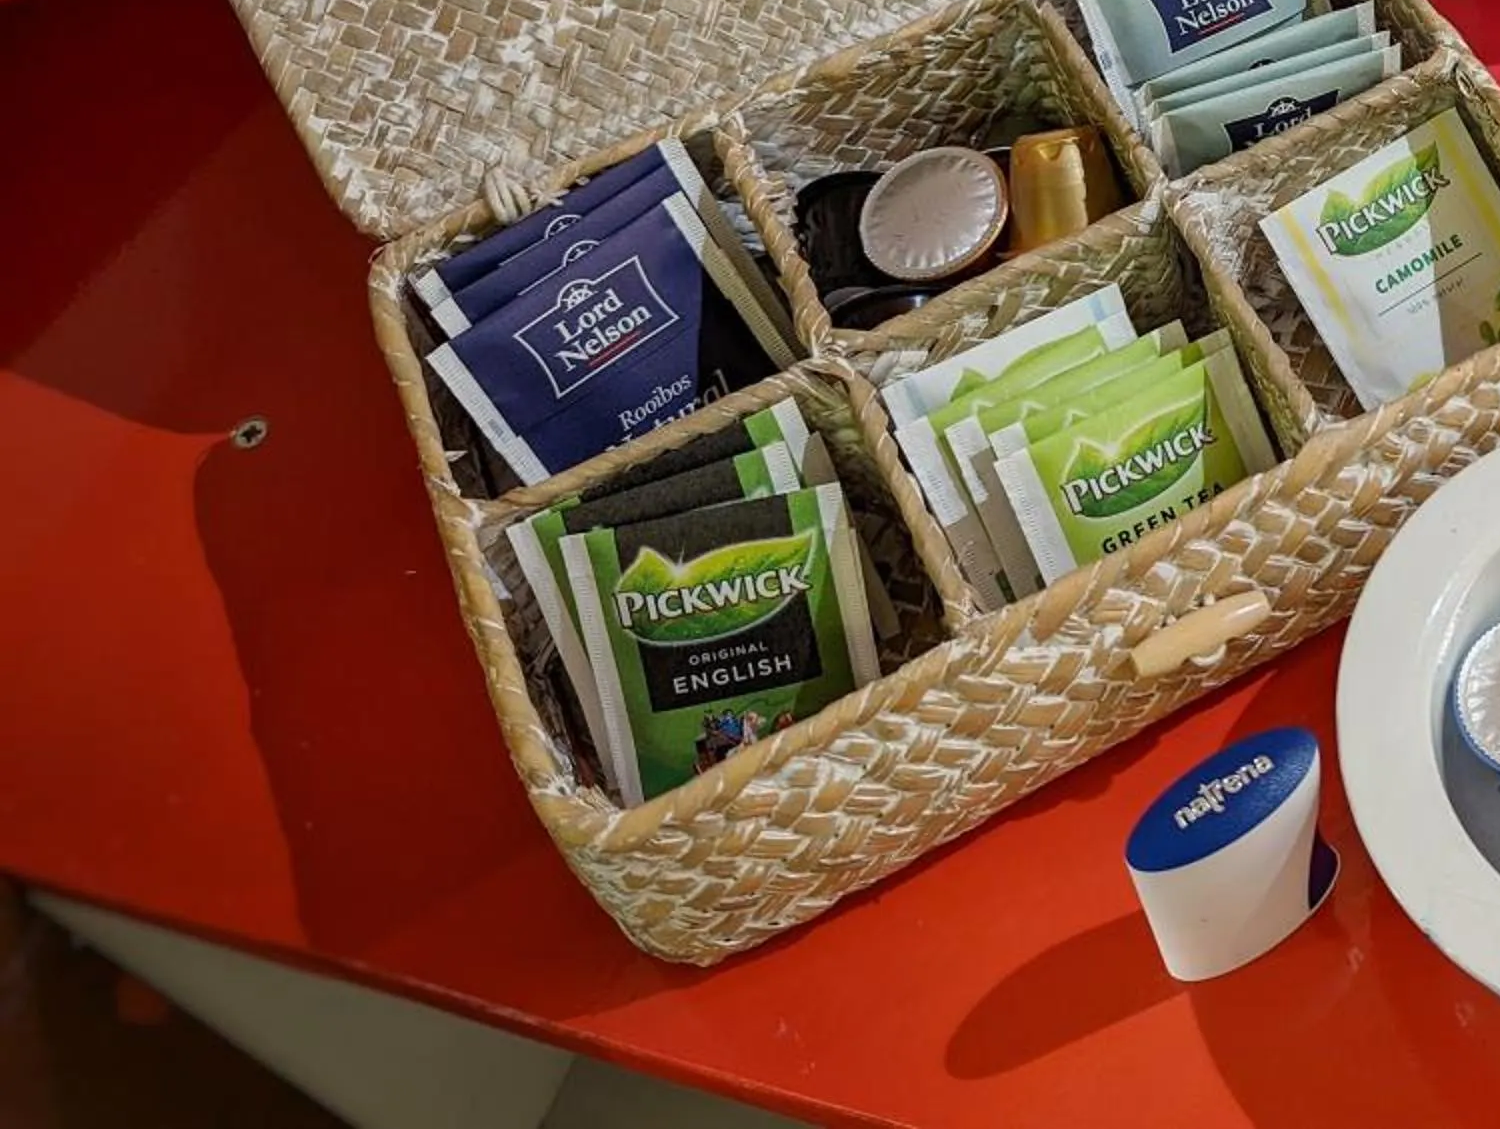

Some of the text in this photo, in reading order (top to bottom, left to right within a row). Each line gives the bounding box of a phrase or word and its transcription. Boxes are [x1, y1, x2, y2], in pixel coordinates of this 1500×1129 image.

[1315, 167, 1451, 256] PICKWICK
[1375, 234, 1464, 294] CAMOMILE
[553, 288, 625, 345] Lord
[554, 303, 653, 373] Nelson
[618, 373, 693, 432] Rooibos
[1060, 421, 1218, 515] PICKWICK
[1102, 506, 1177, 555] GREEN
[613, 564, 813, 628] PICKWICK
[672, 654, 794, 696] ENGLISH
[688, 641, 770, 667] ORIGINAL
[1173, 754, 1275, 830] natrena
